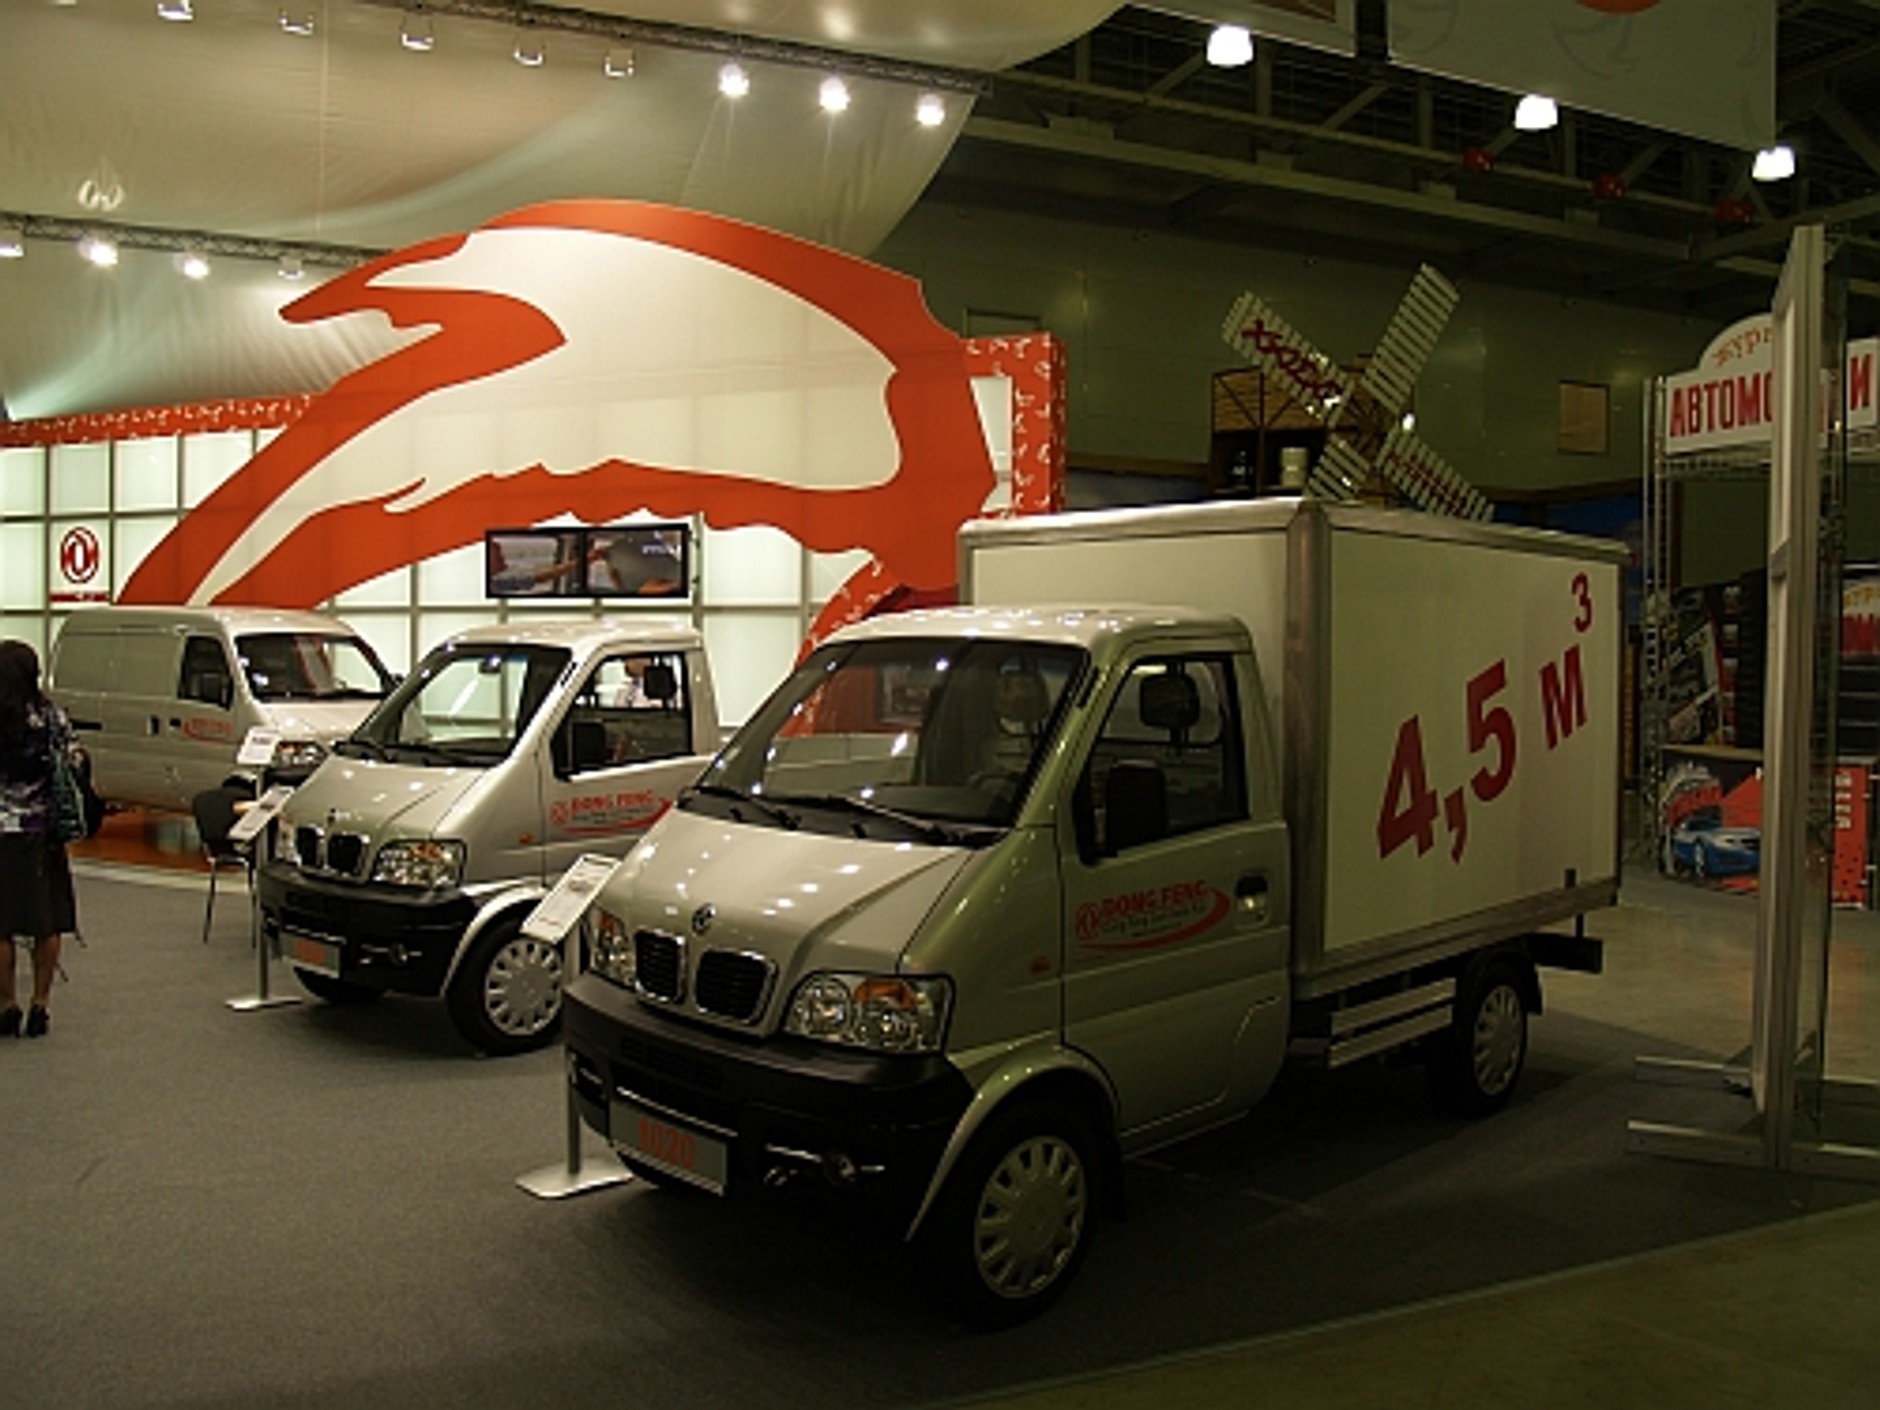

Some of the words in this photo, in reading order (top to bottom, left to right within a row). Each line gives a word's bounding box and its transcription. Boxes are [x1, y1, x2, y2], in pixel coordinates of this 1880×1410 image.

[1572, 571, 1592, 633] 3
[1377, 657, 1516, 865] 4,5
[1101, 887, 1156, 918] DONG
[1161, 879, 1206, 907] FENG
